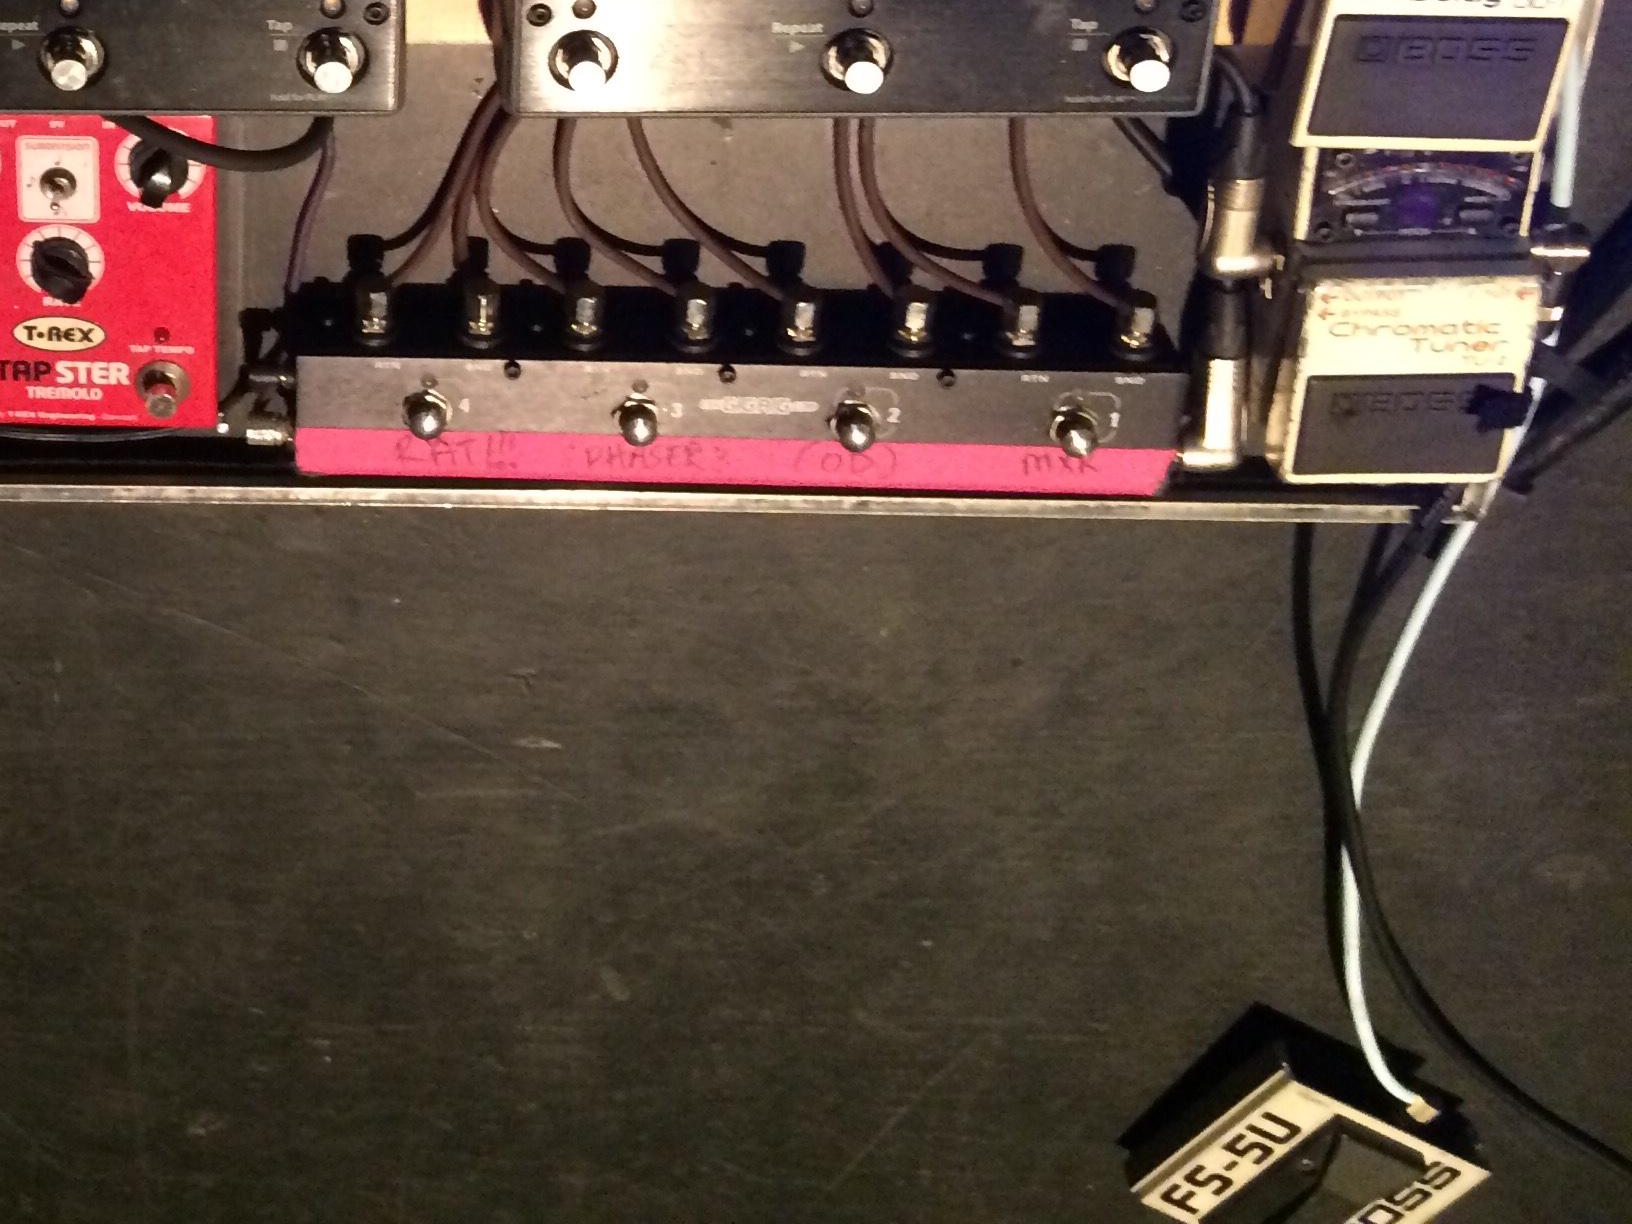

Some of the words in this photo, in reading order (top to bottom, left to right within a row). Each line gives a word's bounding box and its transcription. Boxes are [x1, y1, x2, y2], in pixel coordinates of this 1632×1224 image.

[771, 21, 824, 35] Repeat
[1328, 320, 1503, 337] Chromatic
[1408, 337, 1510, 353] Tuner
[886, 407, 901, 424] 2
[1109, 412, 1120, 429] 1
[1159, 1110, 1303, 1216] FS-5U
[1346, 1160, 1463, 1224] OSS
